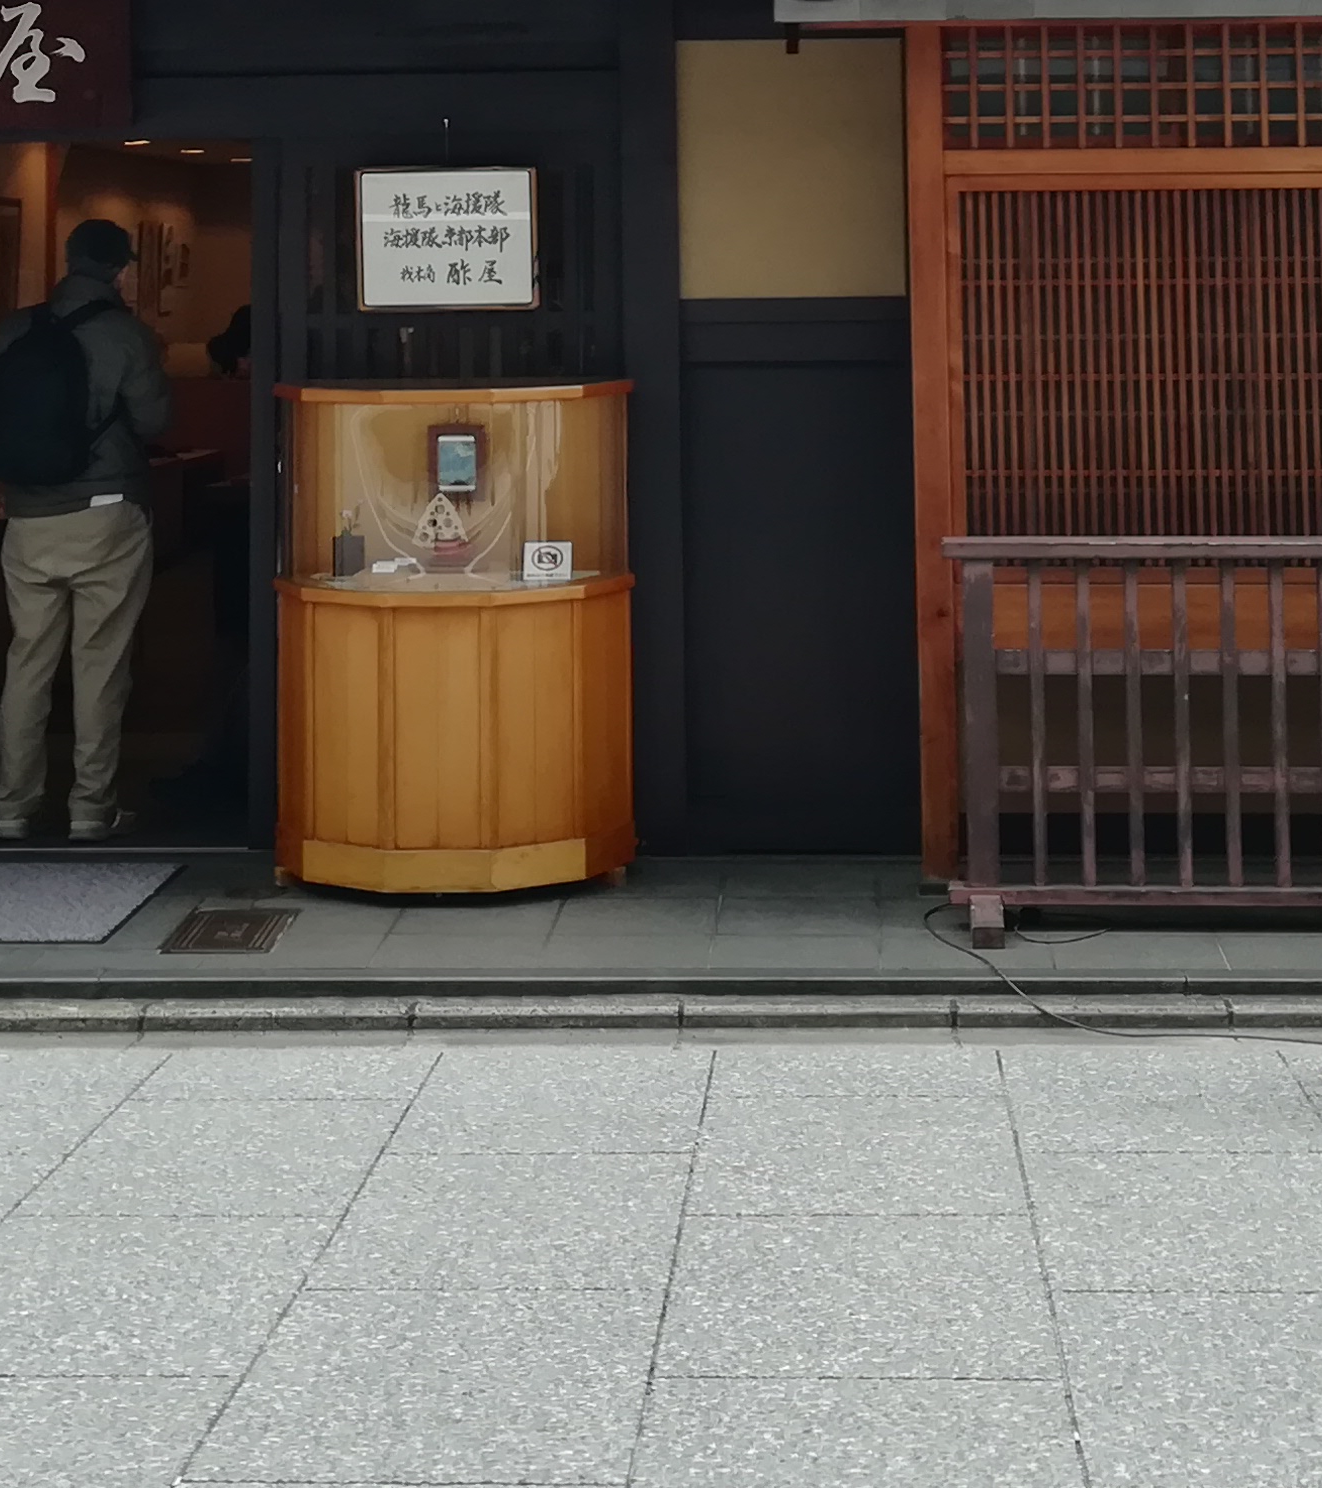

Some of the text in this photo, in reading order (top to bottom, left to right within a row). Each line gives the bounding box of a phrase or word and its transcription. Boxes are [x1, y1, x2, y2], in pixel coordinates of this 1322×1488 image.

[389, 189, 508, 219] 龍馬と海援隊
[383, 224, 511, 253] 海援隊京都本部
